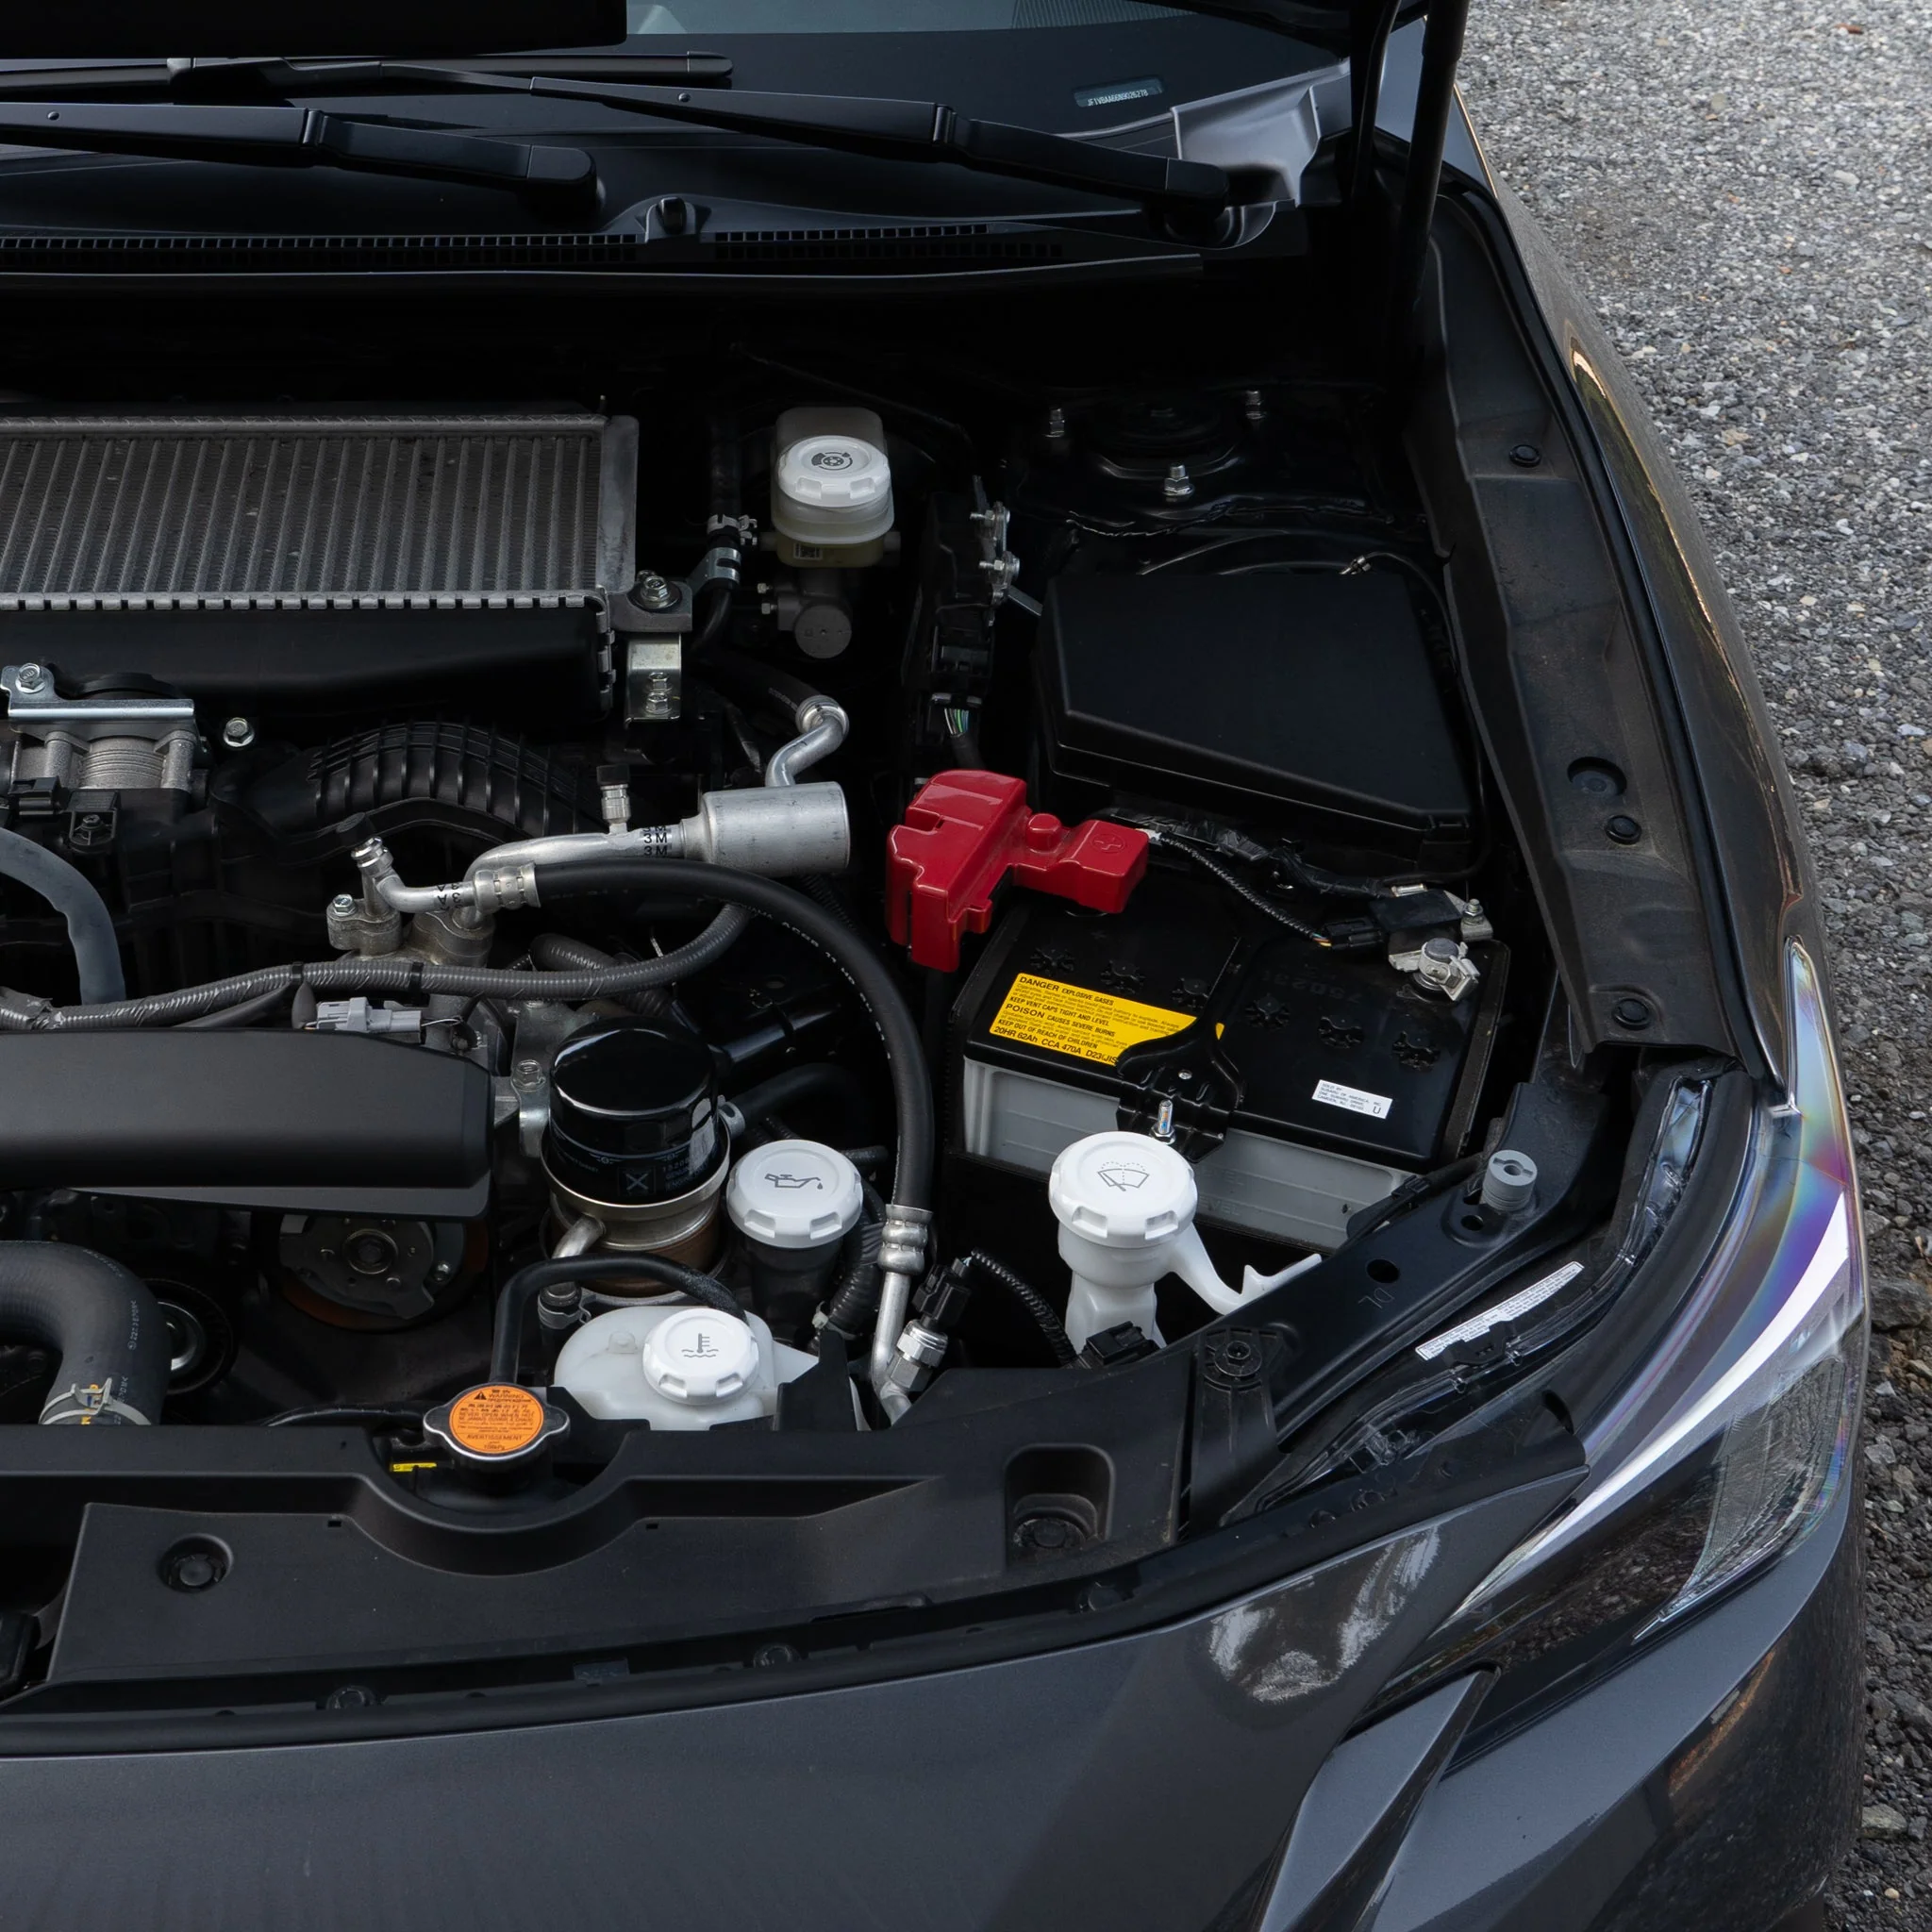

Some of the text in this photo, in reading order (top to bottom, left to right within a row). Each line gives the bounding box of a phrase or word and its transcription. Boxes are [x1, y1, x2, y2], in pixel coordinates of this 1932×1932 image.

[1019, 976, 1114, 1006] DANGER EXPLOSIVE GASES
[1006, 1003, 1045, 1019] POISON
[1046, 1014, 1071, 1025] CAUSES
[1071, 1021, 1093, 1031] SEVERE
[1094, 1027, 1116, 1037] BURNS
[1009, 996, 1025, 1005] KEEP
[1025, 1000, 1041, 1008] VENT
[1041, 1004, 1058, 1012] CAPS
[1058, 1008, 1077, 1018] TIGHT
[1091, 1017, 1110, 1026] LEVEL
[993, 1025, 1017, 1037] 20HR
[1041, 1038, 1061, 1048] CCA
[1061, 1043, 1083, 1055] 470A
[998, 1019, 1014, 1027] KEEP
[1037, 1029, 1058, 1039] REACH
[1067, 1037, 1098, 1049] CHILDREN
[1372, 1106, 1382, 1115] U
